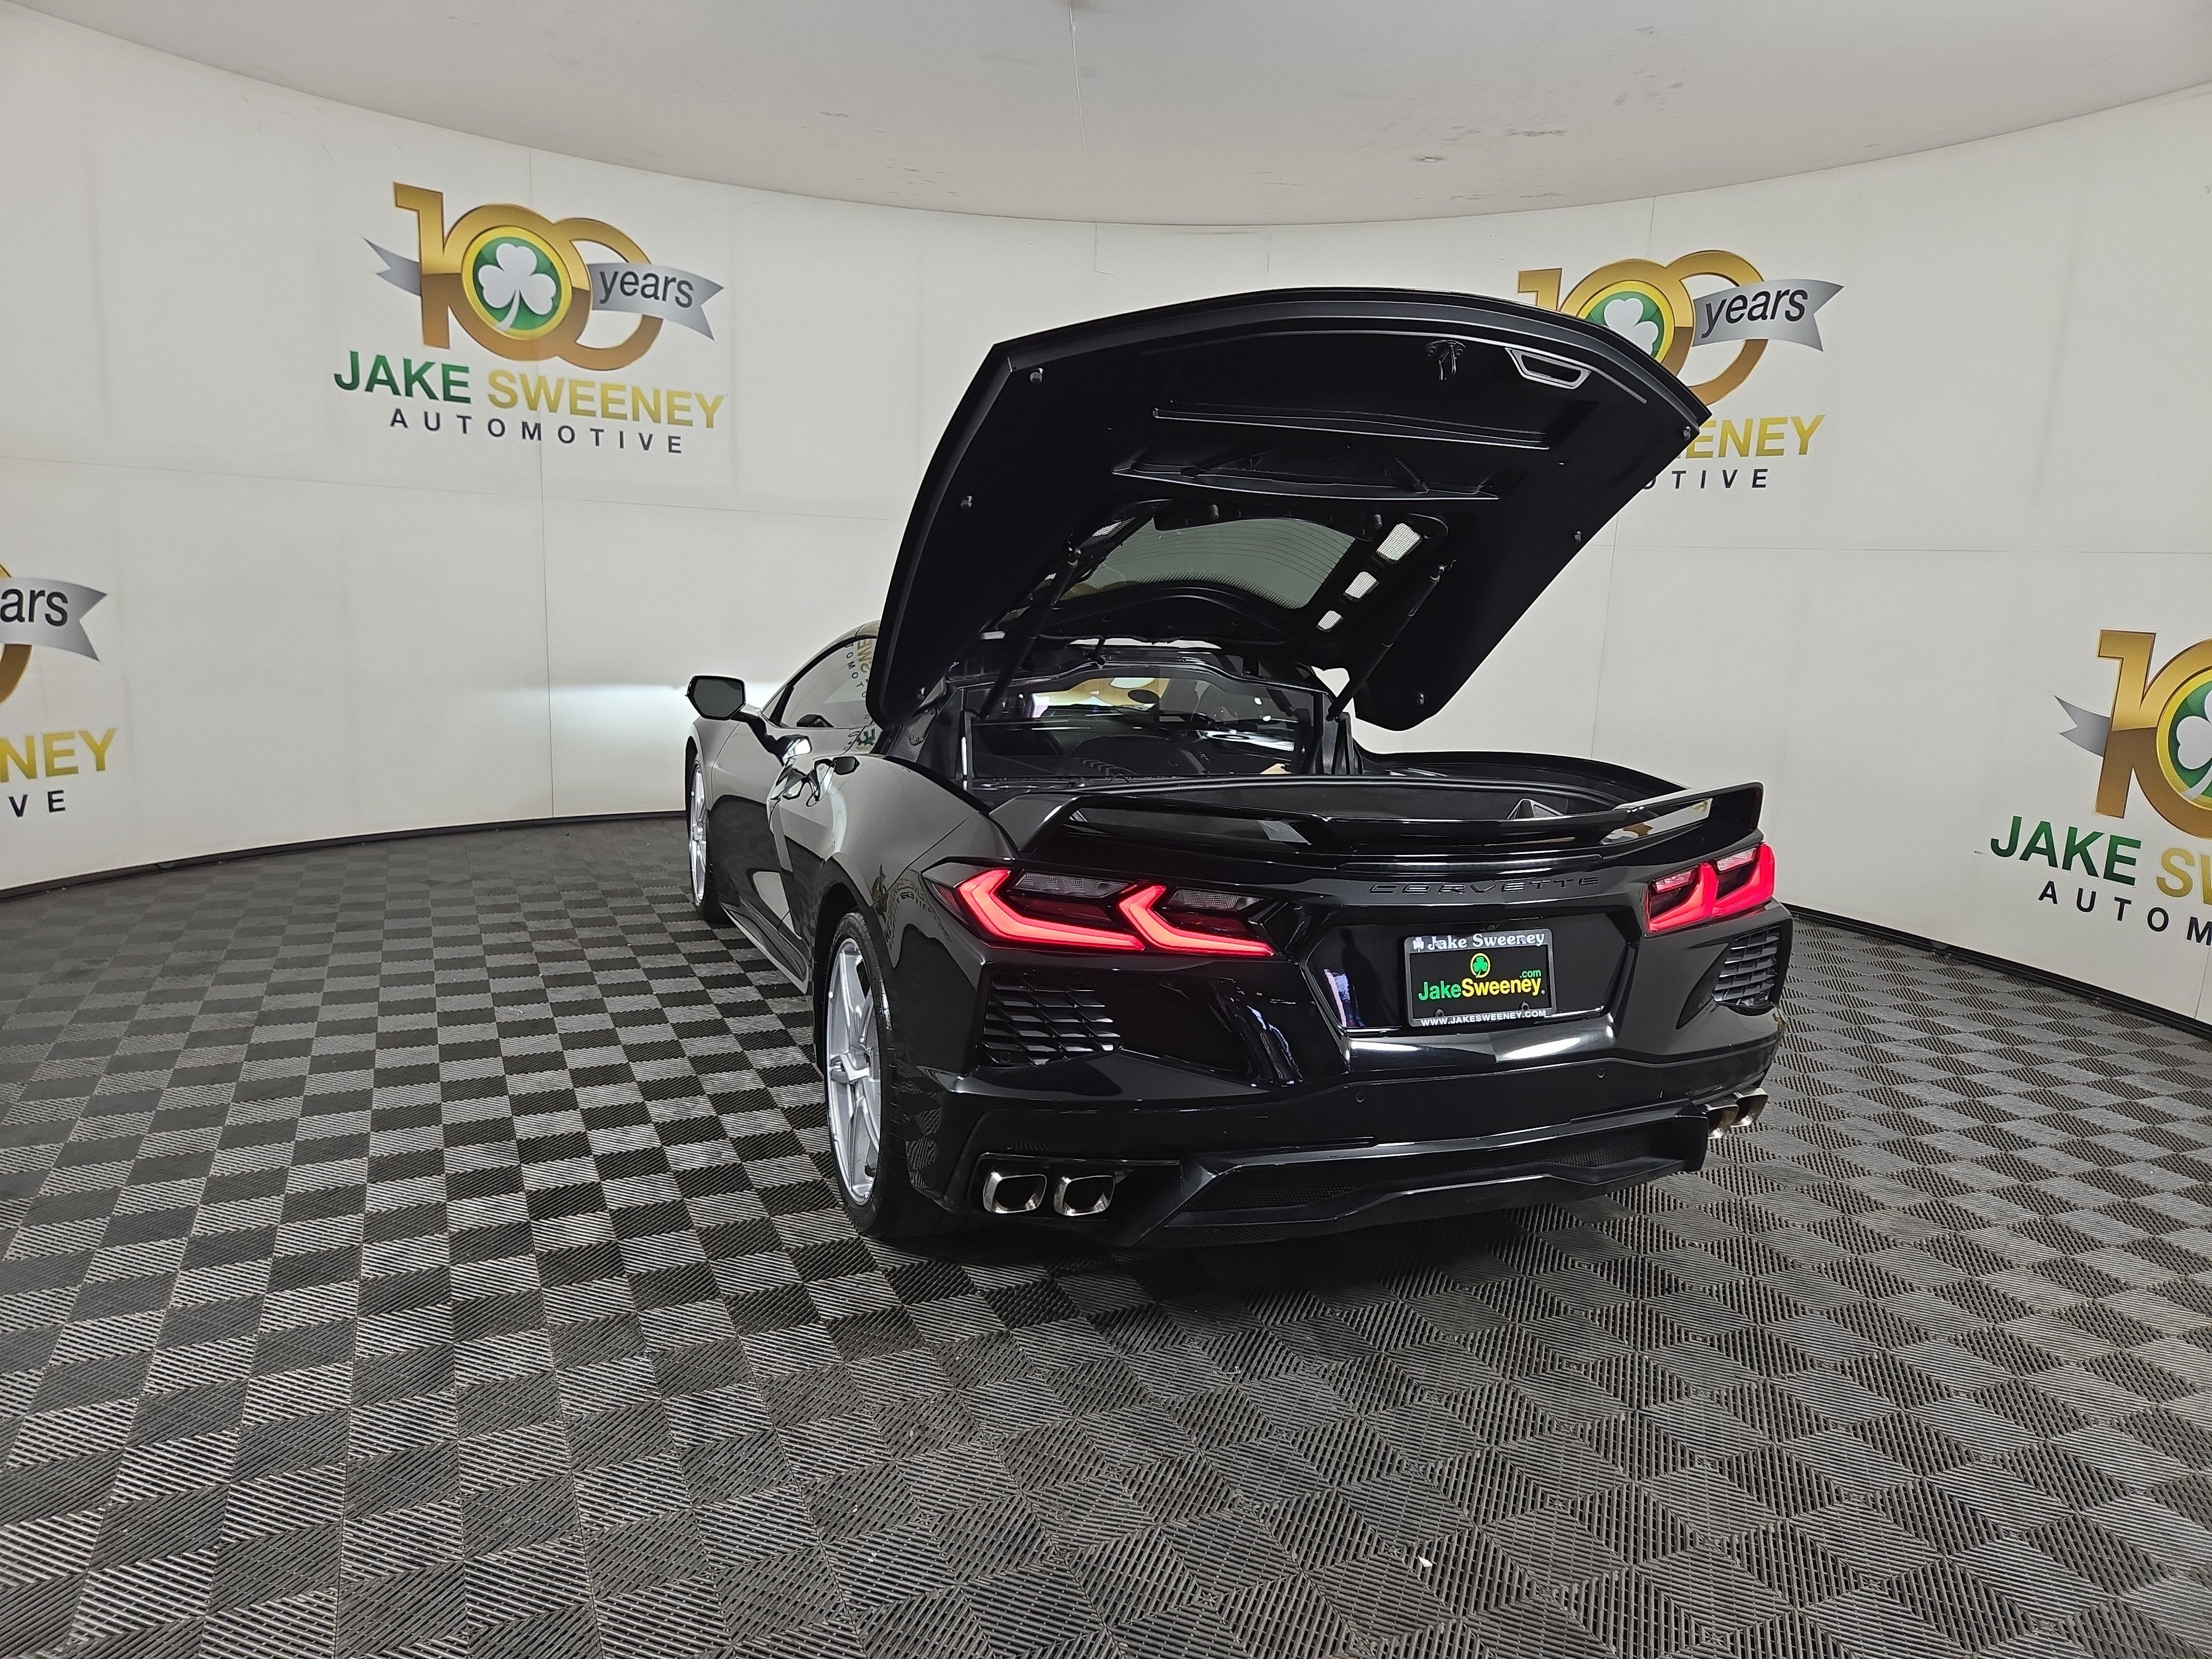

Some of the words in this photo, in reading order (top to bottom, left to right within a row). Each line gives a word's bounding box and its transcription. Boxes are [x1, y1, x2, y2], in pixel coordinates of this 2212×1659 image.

[394, 182, 663, 371] 100
[599, 269, 695, 308] years
[1701, 288, 1808, 339] years
[334, 350, 472, 404] JAKE
[487, 370, 725, 429] SWEENEY
[390, 408, 683, 454] AUTOMOTIVE
[1677, 414, 1826, 459] ENEY
[0, 587, 68, 627] ars
[8, 789, 66, 818] VE
[1990, 815, 2142, 886] JAKE
[2156, 847, 2212, 905] S
[1368, 876, 1599, 895] CORVETTE
[2038, 880, 2212, 946] AUTOM
[1427, 935, 1468, 950] Jake
[1472, 933, 1545, 947] Sweeney
[1519, 969, 1541, 978] .com
[1421, 1009, 1546, 1027] WWW.JAKESWEENEY.COM
